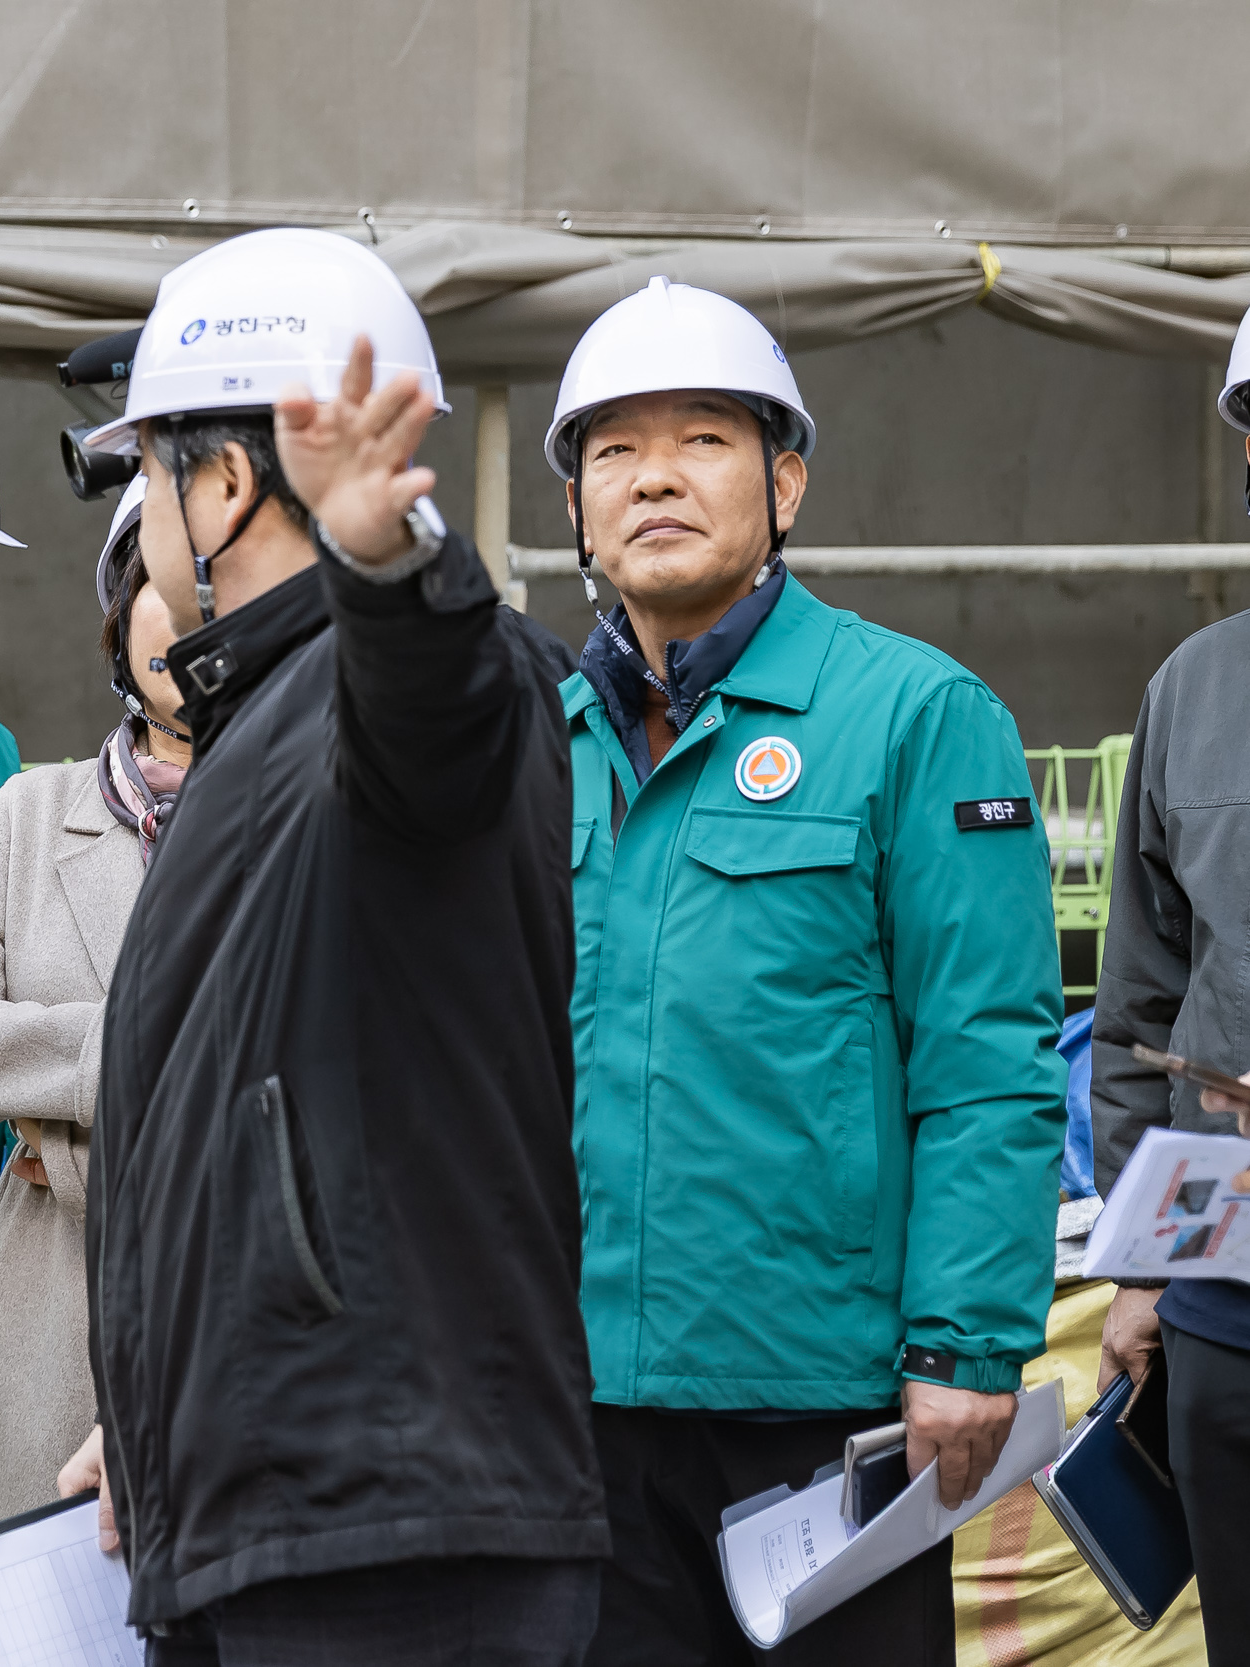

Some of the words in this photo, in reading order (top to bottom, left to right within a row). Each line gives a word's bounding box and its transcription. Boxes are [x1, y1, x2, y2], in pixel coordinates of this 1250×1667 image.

[595, 609, 619, 638] SAFETY
[613, 634, 634, 656] FIRST
[978, 801, 1016, 821] 광진구
[801, 1518, 811, 1536] 보고
[803, 1537, 815, 1557] 점검
